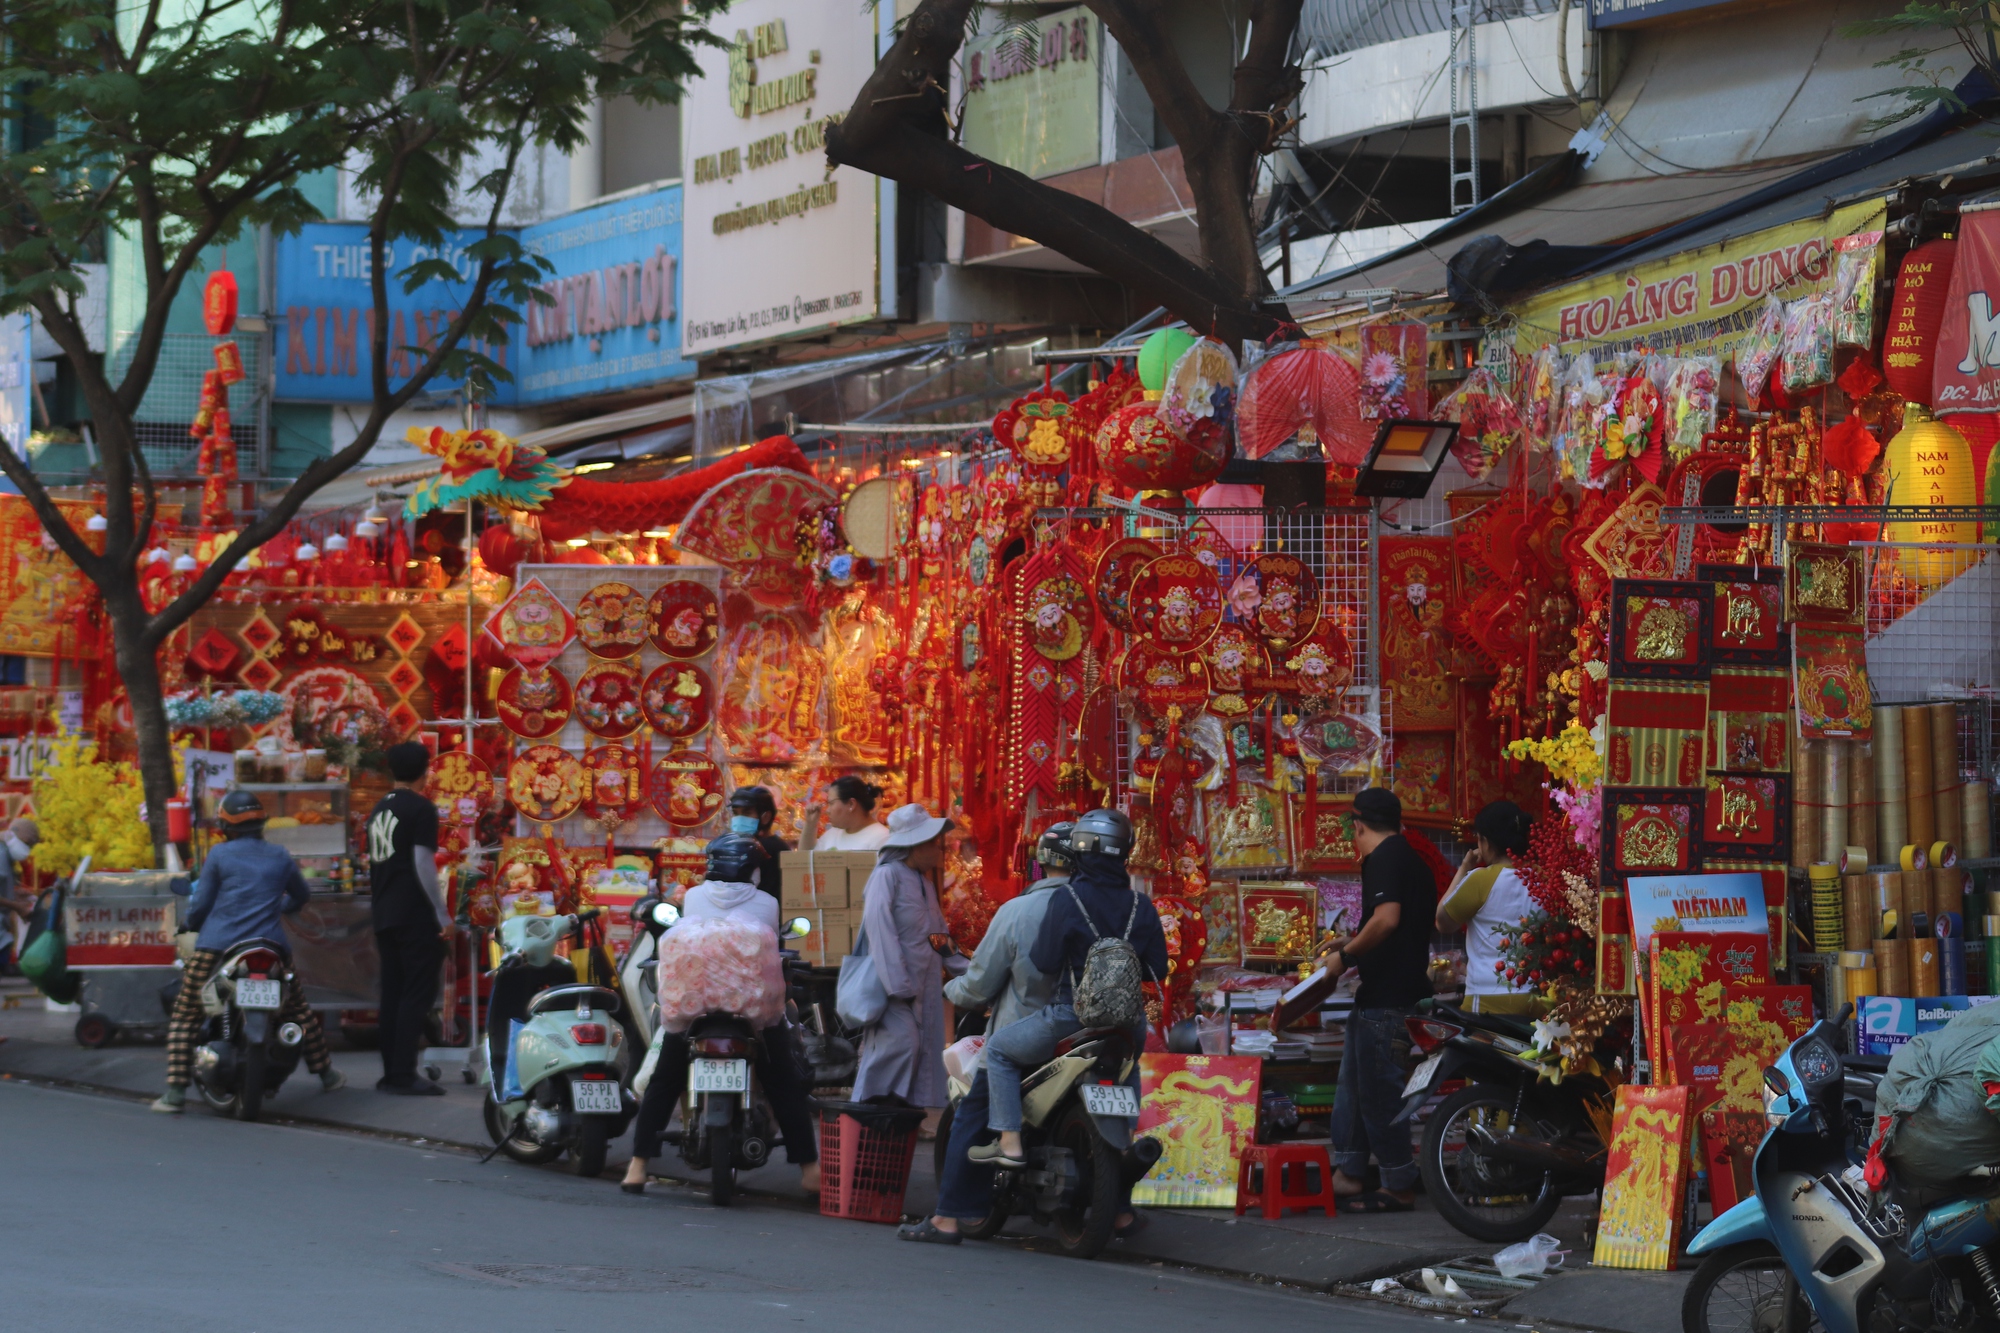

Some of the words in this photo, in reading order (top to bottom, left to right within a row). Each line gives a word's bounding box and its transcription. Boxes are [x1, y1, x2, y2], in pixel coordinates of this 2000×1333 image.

[1904, 263, 1932, 273] NAM
[1904, 275, 1924, 287] MÔ
[1558, 270, 1699, 344] HOÀNG
[1709, 234, 1834, 307] DUNG
[1906, 293, 1915, 302] A
[1902, 307, 1916, 317] DI
[1898, 319, 1916, 332] ĐÀ
[286, 305, 358, 376] KIM
[1891, 336, 1923, 349] PHẬT
[1939, 385, 1969, 401] ĐC:
[1917, 452, 1949, 461] NAM
[1922, 464, 1945, 476] MÔ
[1930, 482, 1940, 490] A
[1930, 495, 1944, 504] DI
[1921, 523, 1956, 535] PHẬT
[1875, 1035, 1900, 1044] Double
[703, 1062, 737, 1074] 59-F1
[699, 1075, 742, 1089] 019.96
[580, 1083, 613, 1096] 59-PA
[1090, 1086, 1126, 1100] 59-L1
[578, 1097, 619, 1111] 044.34
[1089, 1101, 1136, 1114] 817.92
[1792, 1214, 1824, 1222] HONDA
